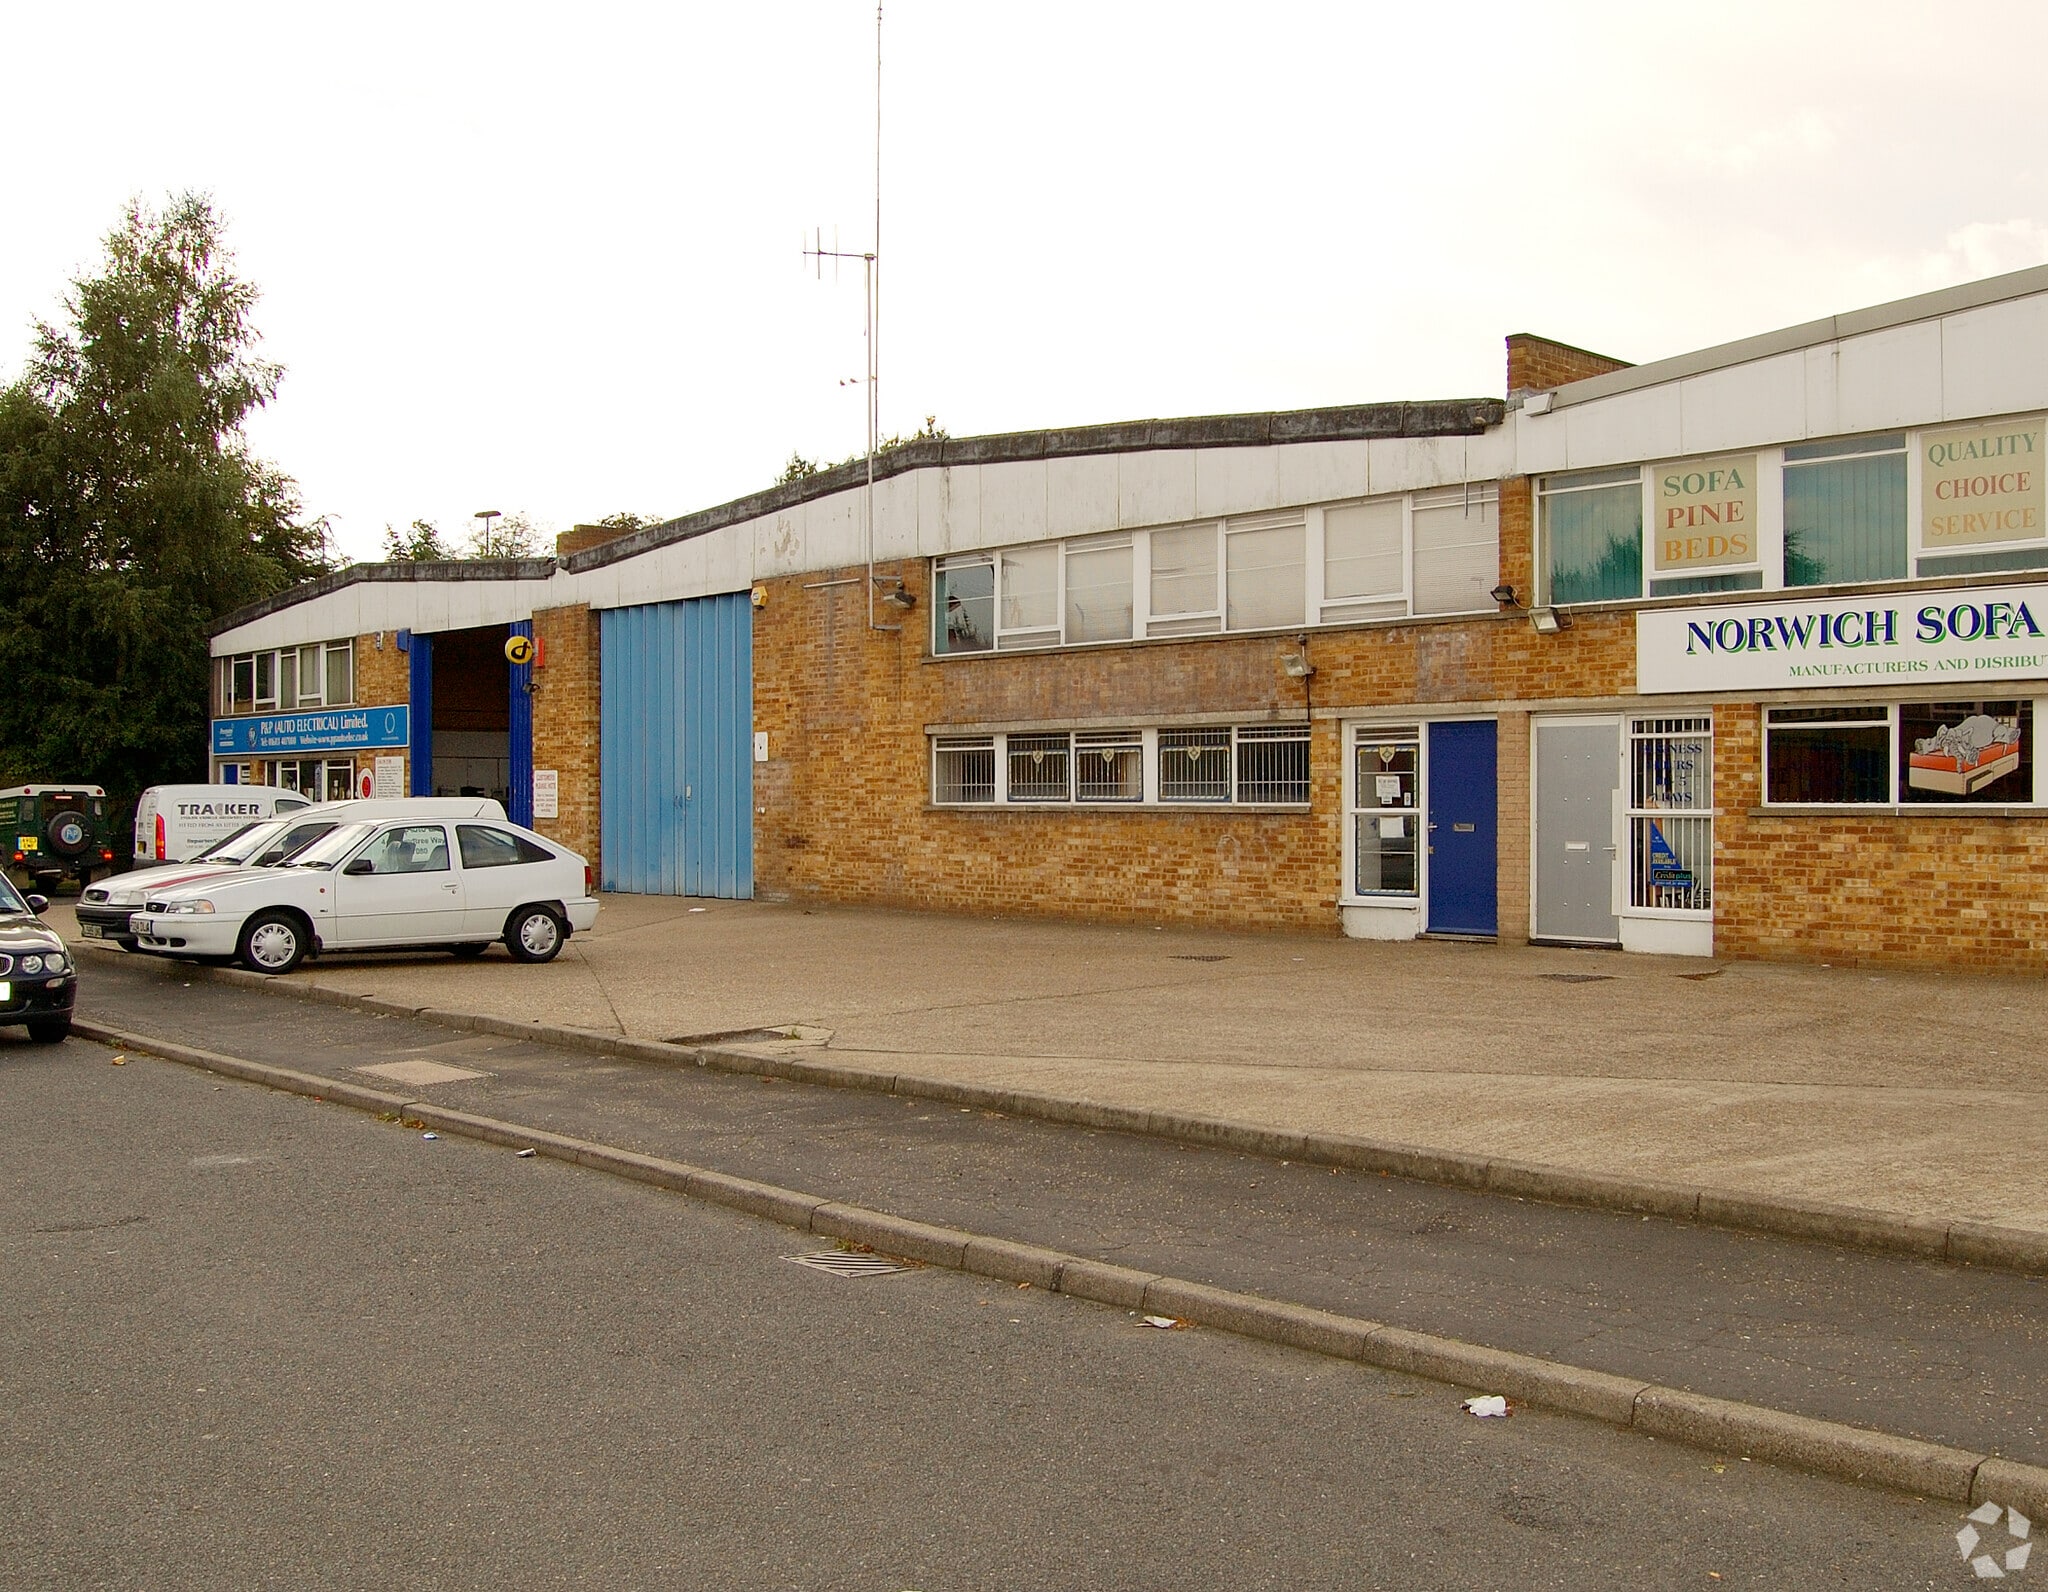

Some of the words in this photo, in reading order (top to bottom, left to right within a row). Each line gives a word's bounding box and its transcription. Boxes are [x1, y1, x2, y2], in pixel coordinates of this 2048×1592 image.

[1928, 432, 2037, 467] QUALITY
[1663, 468, 1745, 497] SOFA
[1935, 471, 2031, 500] CHOICE
[1666, 500, 1744, 529] PINE
[1930, 507, 2036, 537] SERVICE
[1664, 534, 1748, 561] BEDS
[1685, 608, 1898, 656] NORWICH
[1915, 600, 2046, 642] SOFA
[1789, 659, 1928, 678] MANUFACTURERS
[1933, 656, 1969, 671] AND
[178, 803, 260, 815] TRACKER
